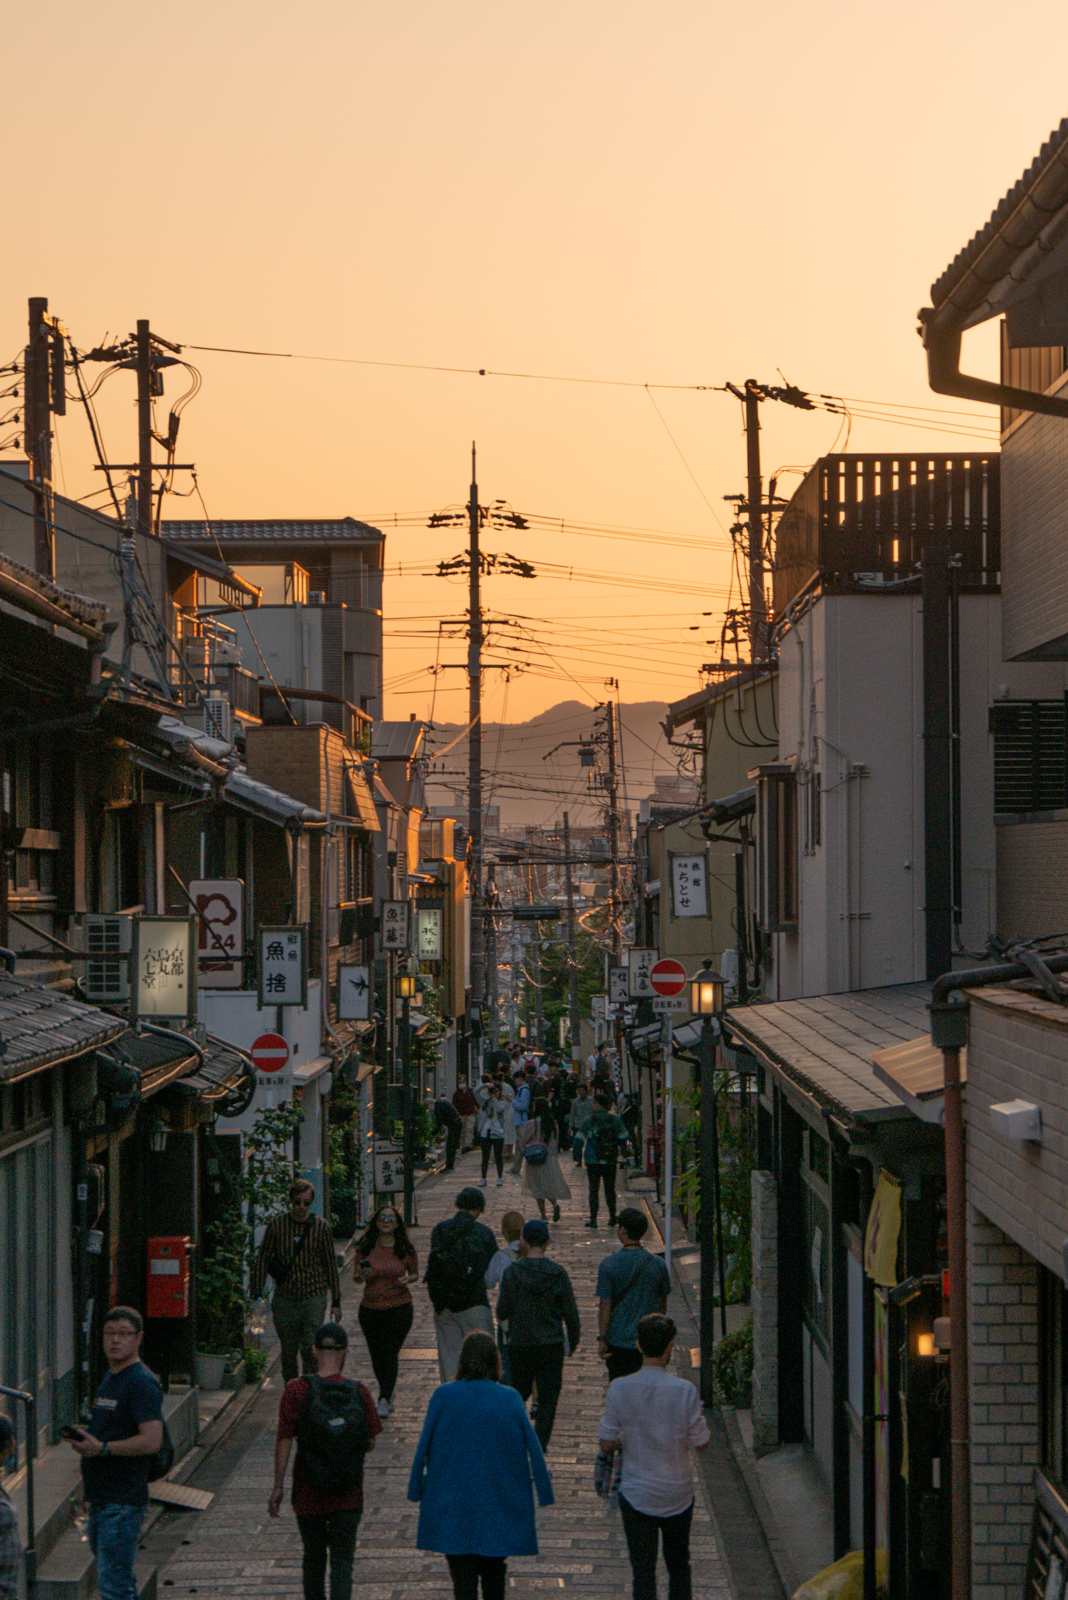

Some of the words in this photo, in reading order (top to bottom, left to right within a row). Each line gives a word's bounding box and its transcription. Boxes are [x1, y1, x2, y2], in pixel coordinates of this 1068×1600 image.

[679, 871, 691, 907] ちとせ
[210, 933, 236, 950] 24
[170, 947, 185, 976] 京都
[266, 941, 286, 993] 魚捨
[259, 1076, 289, 1085] 転車を除く
